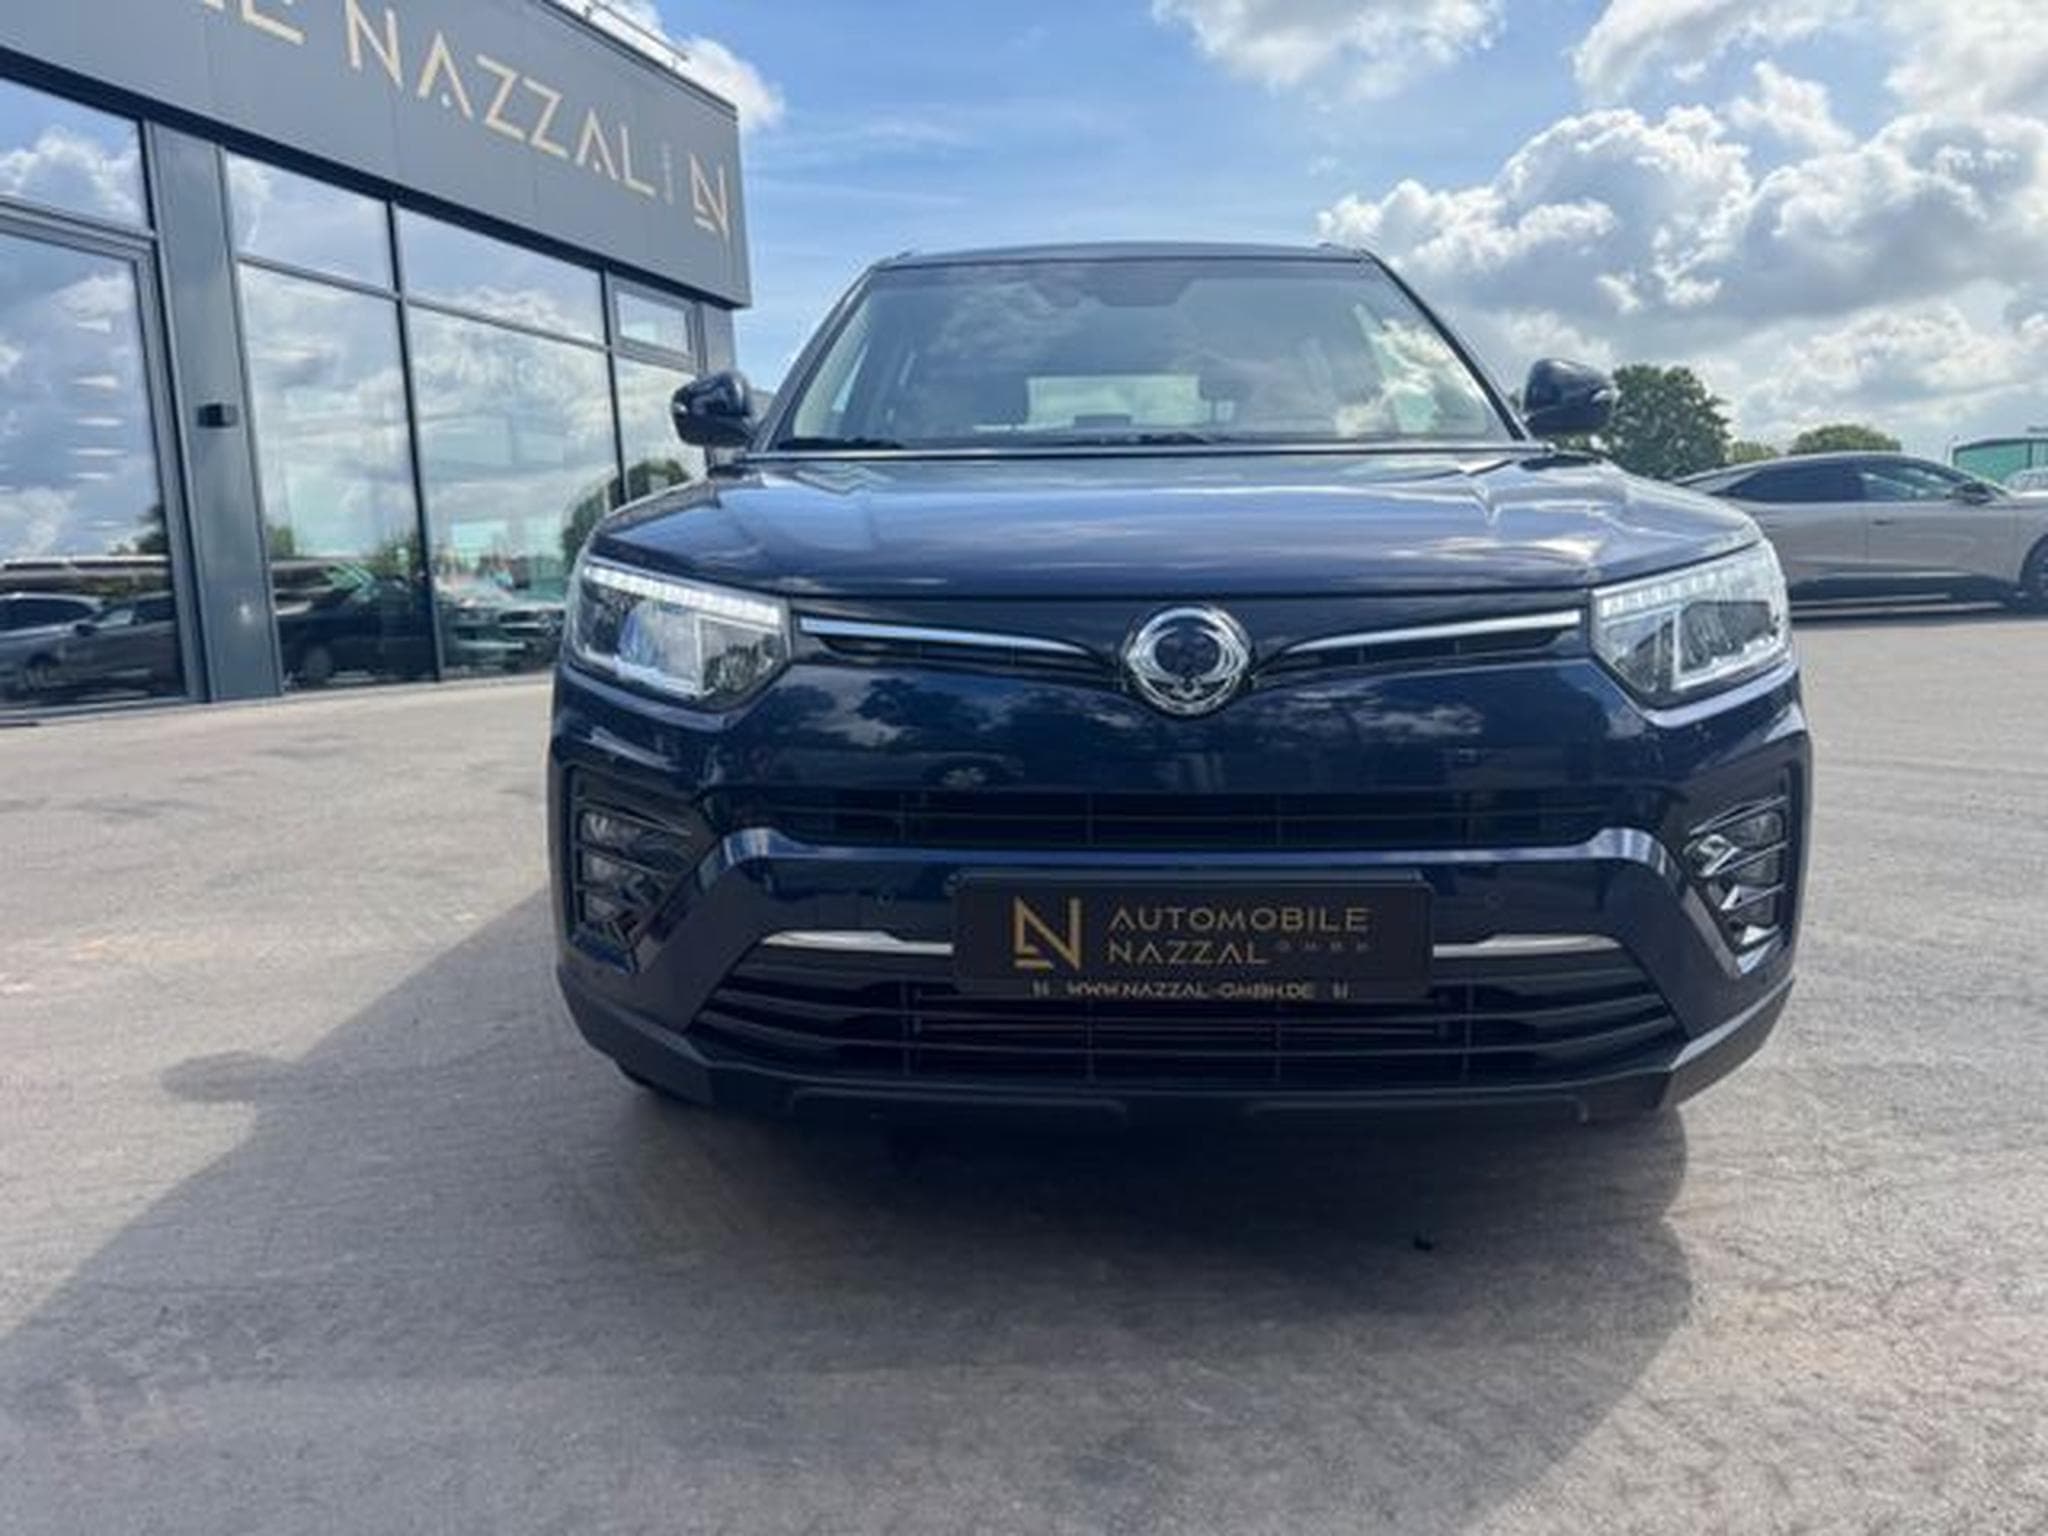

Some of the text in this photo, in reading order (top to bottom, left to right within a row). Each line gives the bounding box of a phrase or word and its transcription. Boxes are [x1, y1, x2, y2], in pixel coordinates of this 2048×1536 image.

[344, 0, 656, 197] NAZZAL
[1108, 906, 1371, 933] AUTOMOBILE
[1108, 940, 1270, 966] NAZZAL
